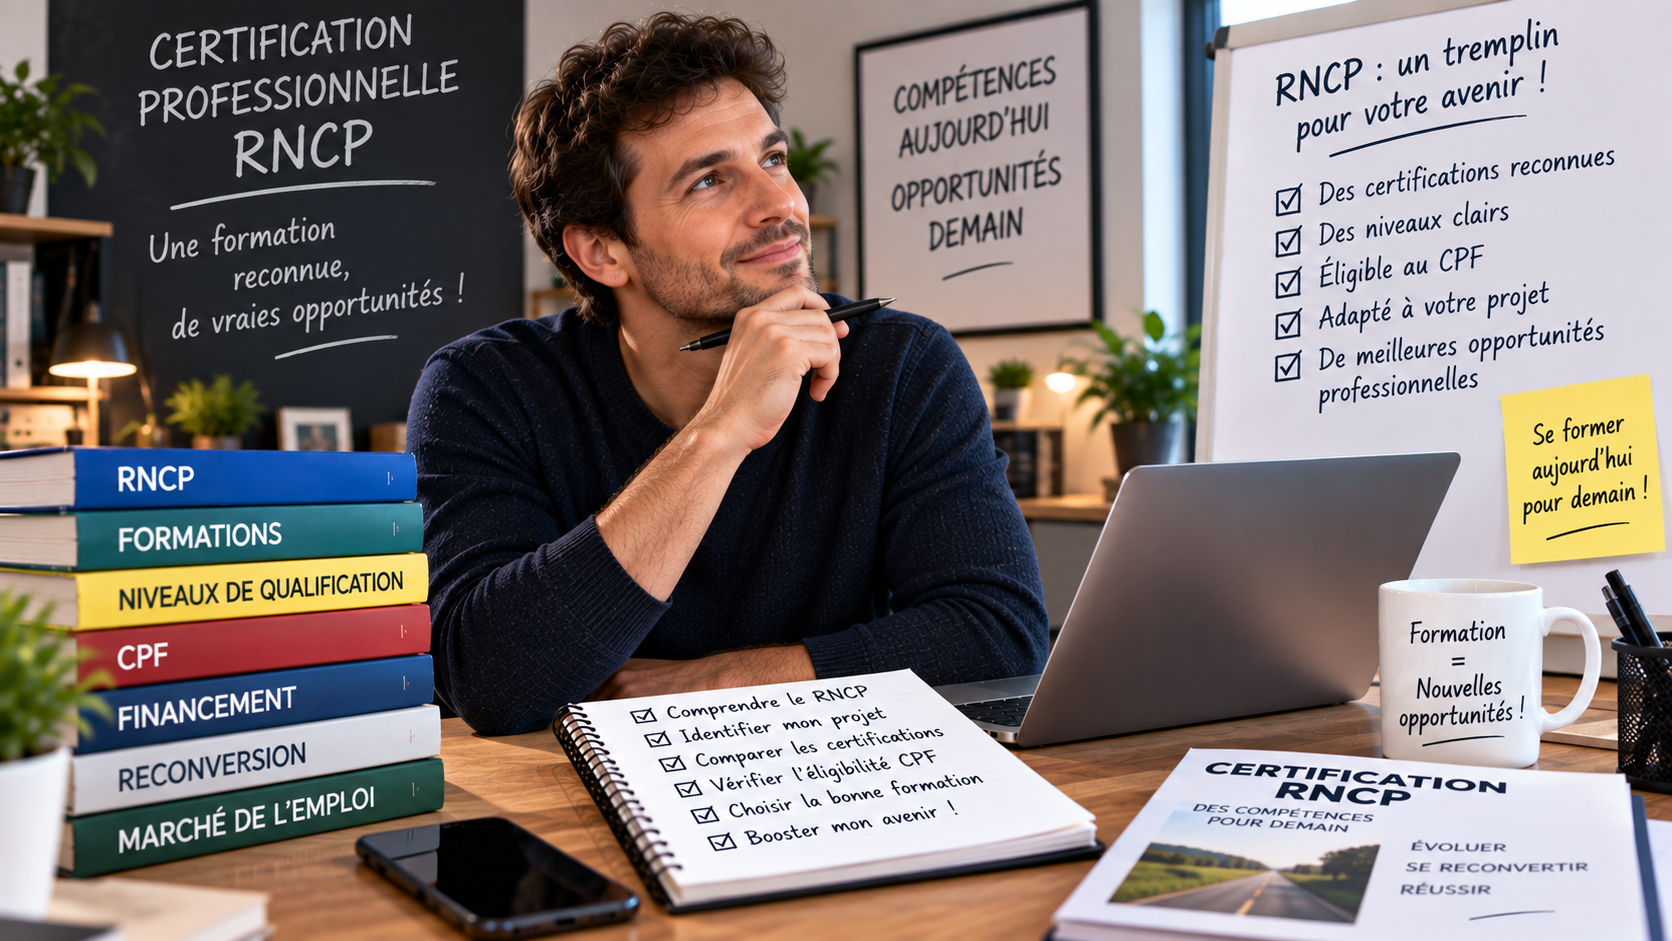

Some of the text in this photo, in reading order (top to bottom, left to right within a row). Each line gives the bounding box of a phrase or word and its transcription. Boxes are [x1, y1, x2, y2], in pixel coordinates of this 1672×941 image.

[150, 13, 412, 70] CERTIFICATION
[1276, 58, 1363, 107] RNCP
[1398, 54, 1429, 76] un
[1443, 18, 1559, 67] tremplin
[138, 59, 459, 126] PROFESSIONNELLE
[894, 55, 1056, 114] COMPÉTENCES
[1297, 60, 1546, 153] pour votre avenir !
[234, 119, 373, 178] RNCP
[899, 102, 1049, 158] AUJOURD'HUI
[891, 150, 1061, 212] OPPORTUNITÉS
[1319, 150, 1615, 206] Des certifications reconnues
[150, 217, 335, 263] Une formation
[929, 207, 1023, 251] DEMAIN
[1319, 201, 1509, 246] Des niveaux clairs
[234, 260, 349, 290] reconnue,
[1320, 244, 1484, 293] Éligible au CPF
[172, 272, 464, 339] de vraies opportunités !
[1319, 281, 1549, 333] Adapté à votre projet
[1319, 317, 1604, 371] De meilleures opportunités
[1319, 365, 1478, 414] professionnelles
[1533, 417, 1625, 446] Se former
[118, 466, 194, 492] RNCP
[1532, 445, 1632, 486] aujourd'hui
[1523, 497, 1563, 525] pour
[1571, 481, 1636, 509] demain
[119, 522, 282, 552] FORMATIONS
[119, 571, 403, 611] NIVEAUX DE QUALIFICATION
[1410, 620, 1506, 644] Formation
[117, 642, 168, 670] CPF
[1452, 657, 1465, 666] =
[667, 685, 867, 720] Comprendre le RNCP
[1417, 673, 1501, 699] Nouvelles
[118, 686, 297, 731] FINANCEMENT
[679, 707, 887, 743] Identifier mon projet
[1400, 700, 1513, 735] opportunités
[119, 742, 306, 792] RECONVERSION
[696, 728, 944, 768] Comparer les certifications
[709, 749, 936, 792] Vérifier l'éligibilité CPF
[1205, 762, 1507, 794] CERTIFICATION
[729, 774, 983, 818] Choisir la bonne formation
[1193, 804, 1373, 822] DES COMPÉTENCES
[1275, 782, 1411, 806] RNCP
[119, 786, 374, 853] MARCHÉ DE L'EMPLOI
[744, 800, 958, 845] Booster mon avenir !
[1207, 816, 1348, 832] POUR DEMAIN
[1406, 862, 1588, 872] SE RECONVERTIR
[1411, 840, 1506, 852] ÉVOLUER
[1400, 882, 1491, 895] RÉUSSIR
